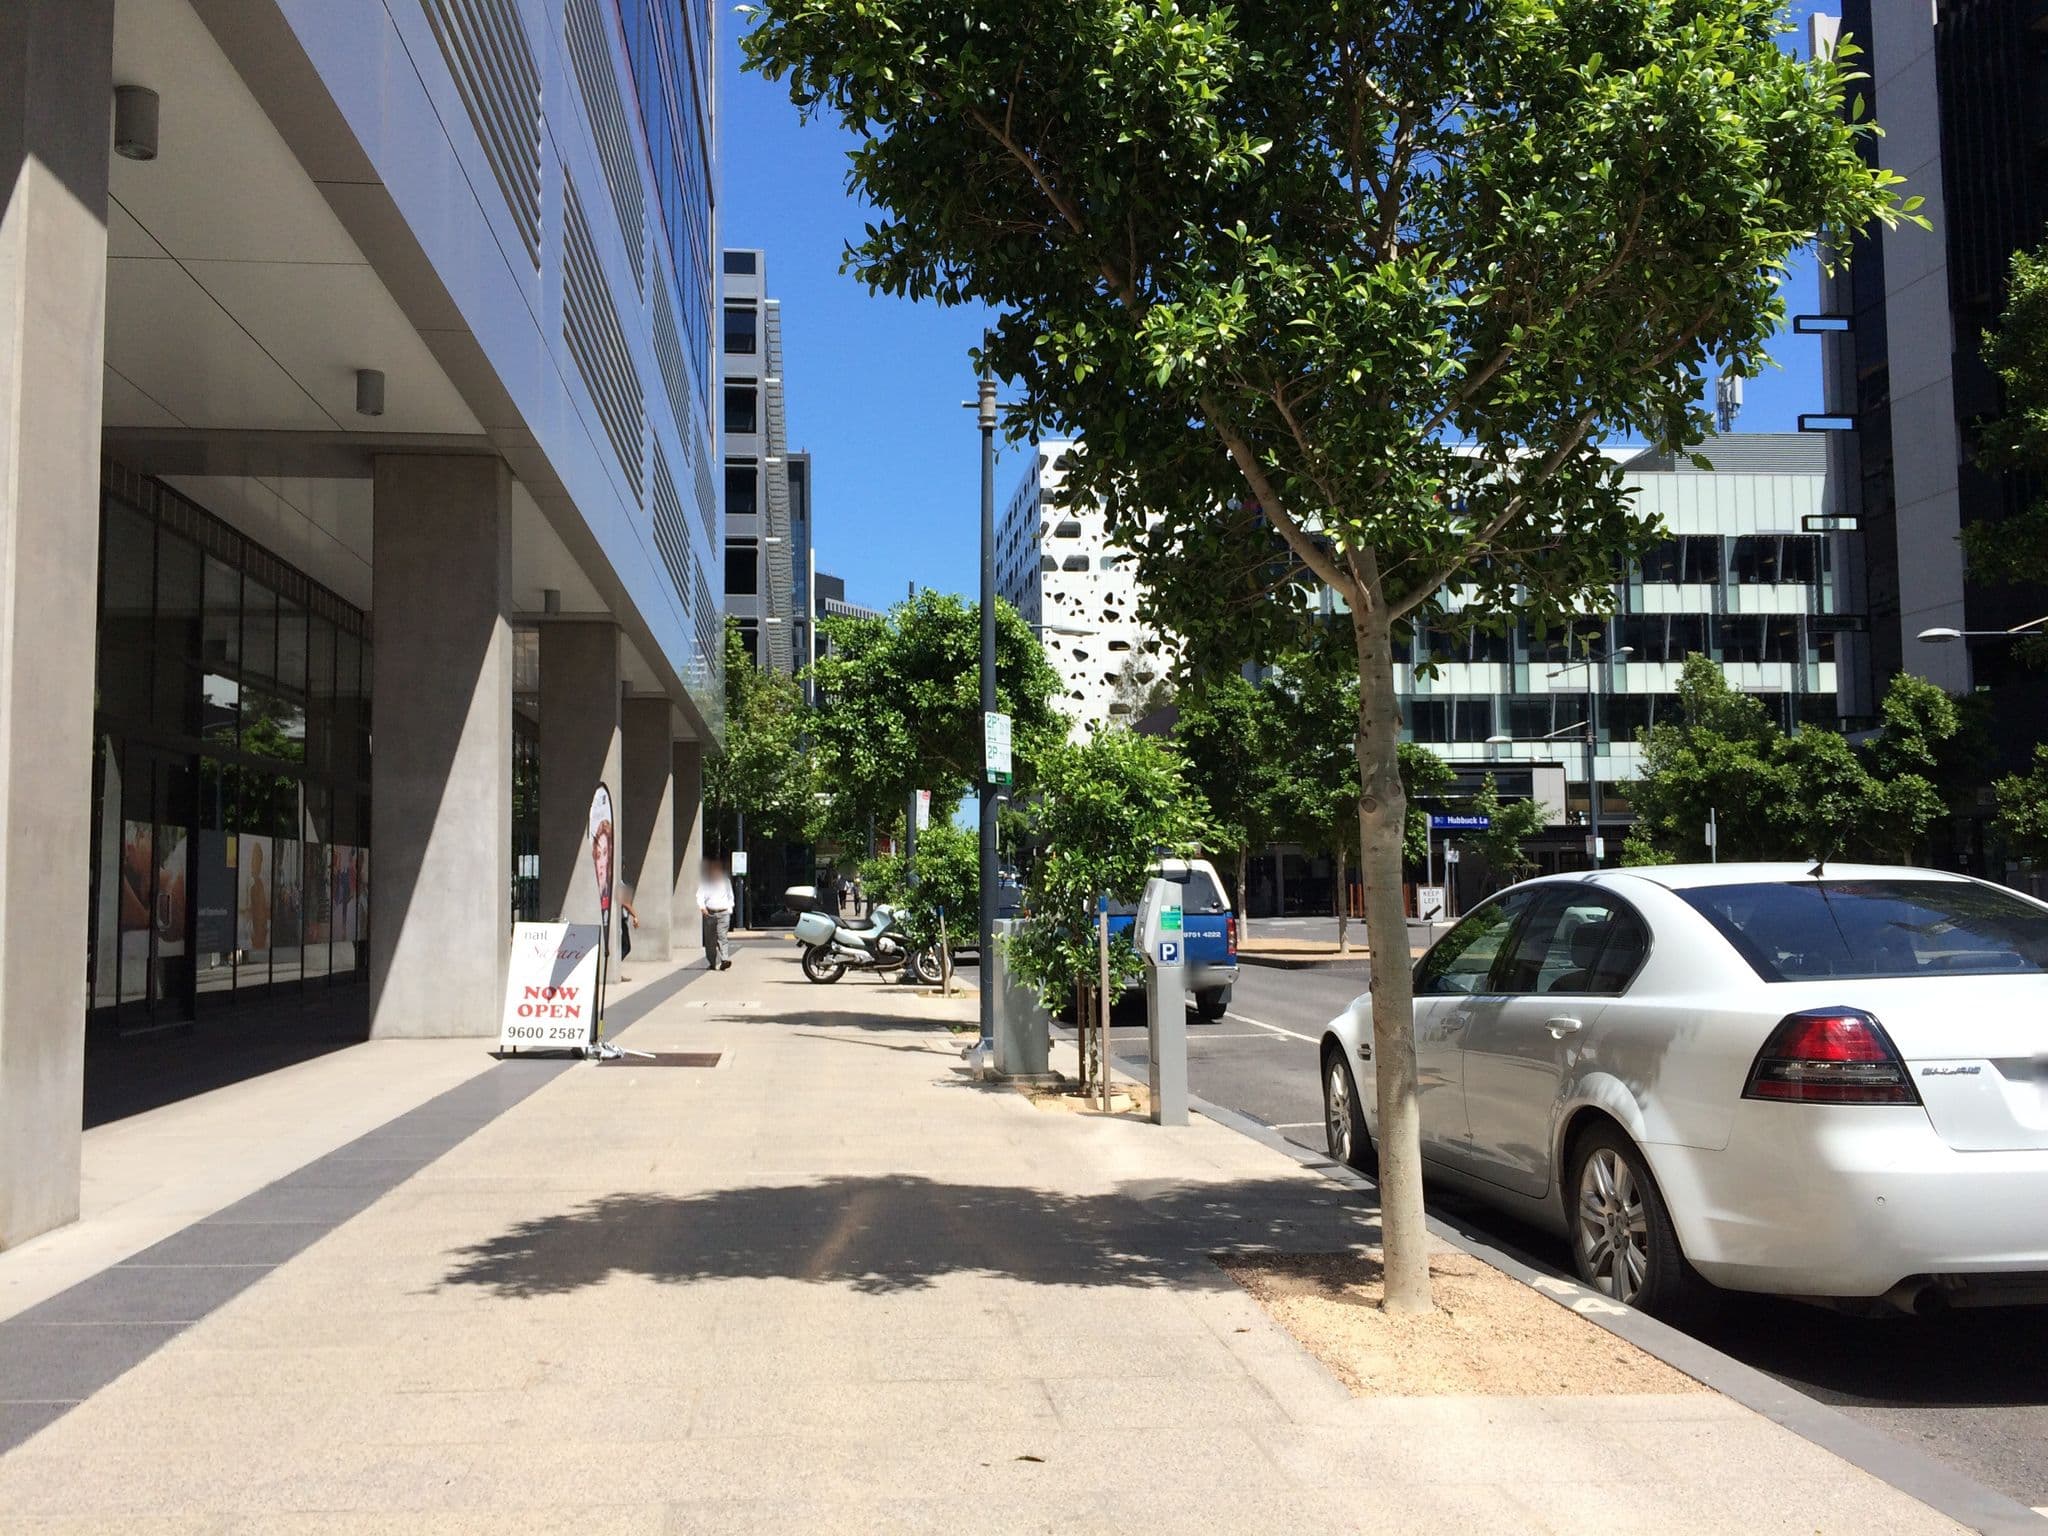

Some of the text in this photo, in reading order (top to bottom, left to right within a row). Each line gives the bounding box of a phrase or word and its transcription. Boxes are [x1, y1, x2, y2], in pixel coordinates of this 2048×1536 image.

[1447, 816, 1488, 825] Hubbuck La
[524, 930, 548, 941] nail
[1162, 943, 1176, 961] P
[524, 986, 580, 1001] NOW
[517, 1003, 581, 1019] OPEN
[507, 1026, 585, 1040] 9600 2587
